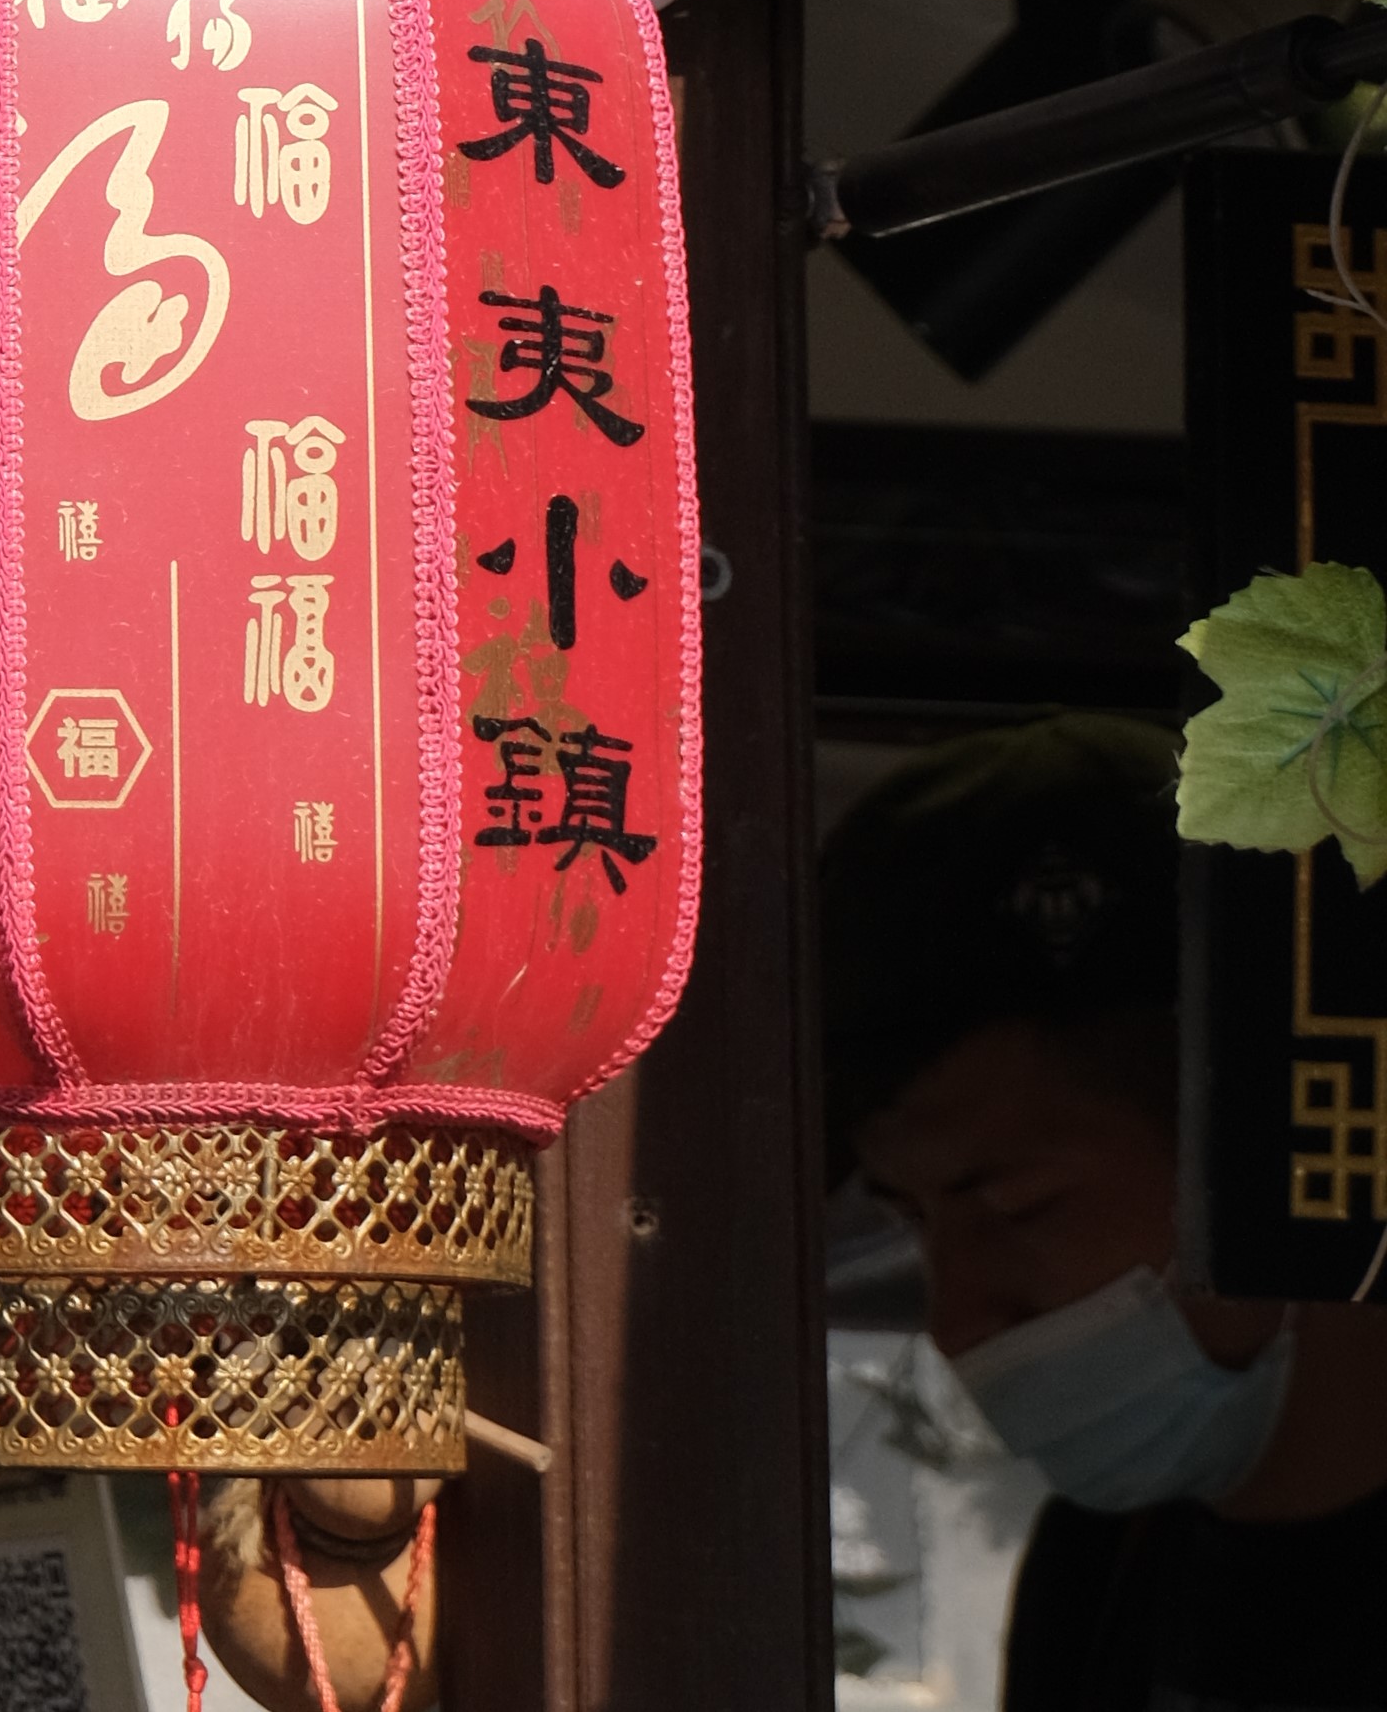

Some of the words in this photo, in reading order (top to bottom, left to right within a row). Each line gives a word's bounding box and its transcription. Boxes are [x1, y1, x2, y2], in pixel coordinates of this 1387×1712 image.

[456, 38, 657, 895] 東夷小鎮
[57, 717, 119, 778] 福
